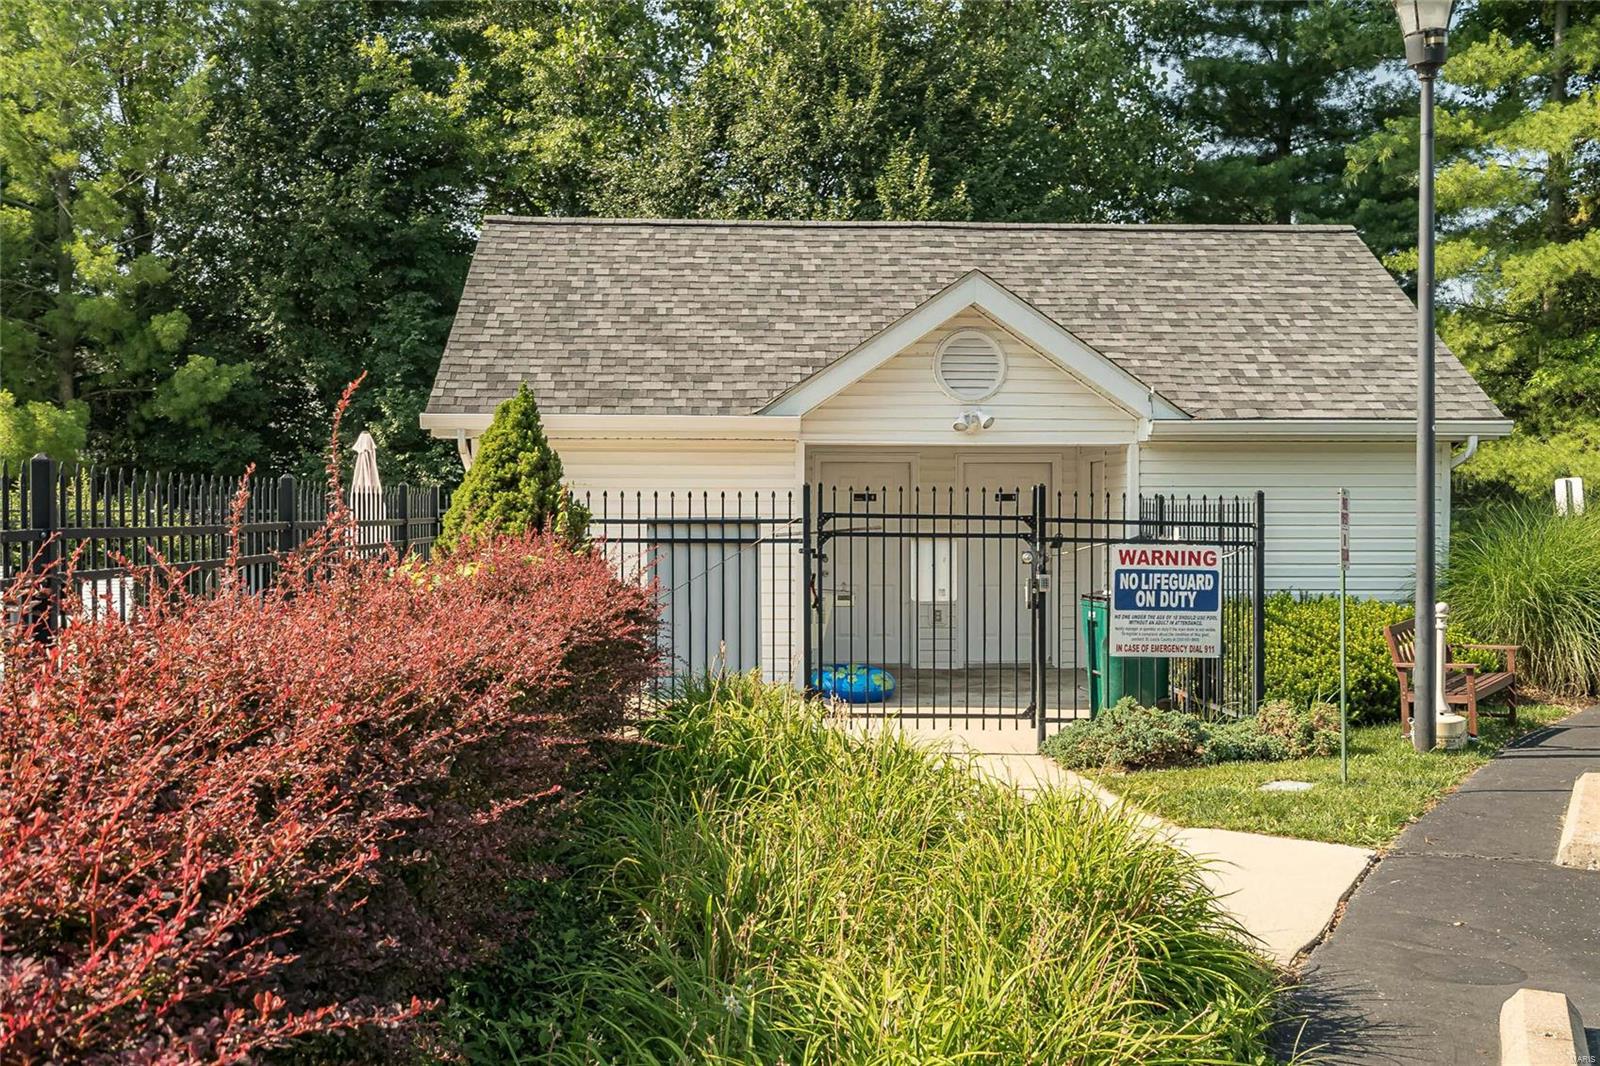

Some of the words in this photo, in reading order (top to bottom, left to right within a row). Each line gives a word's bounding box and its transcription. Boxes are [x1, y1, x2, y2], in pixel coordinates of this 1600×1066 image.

[1119, 549, 1217, 566] WARNING
[1120, 573, 1138, 590] NO
[1141, 573, 1214, 590] LIFEGUARD
[1136, 590, 1155, 607] ON
[1160, 591, 1197, 608] DUTY
[1116, 644, 1123, 652] IN
[1124, 644, 1139, 653] CASE
[1141, 644, 1149, 653] OF
[1151, 644, 1188, 653] EMERGENCY
[1189, 645, 1203, 653] DIAL
[1204, 645, 1215, 653] 911
